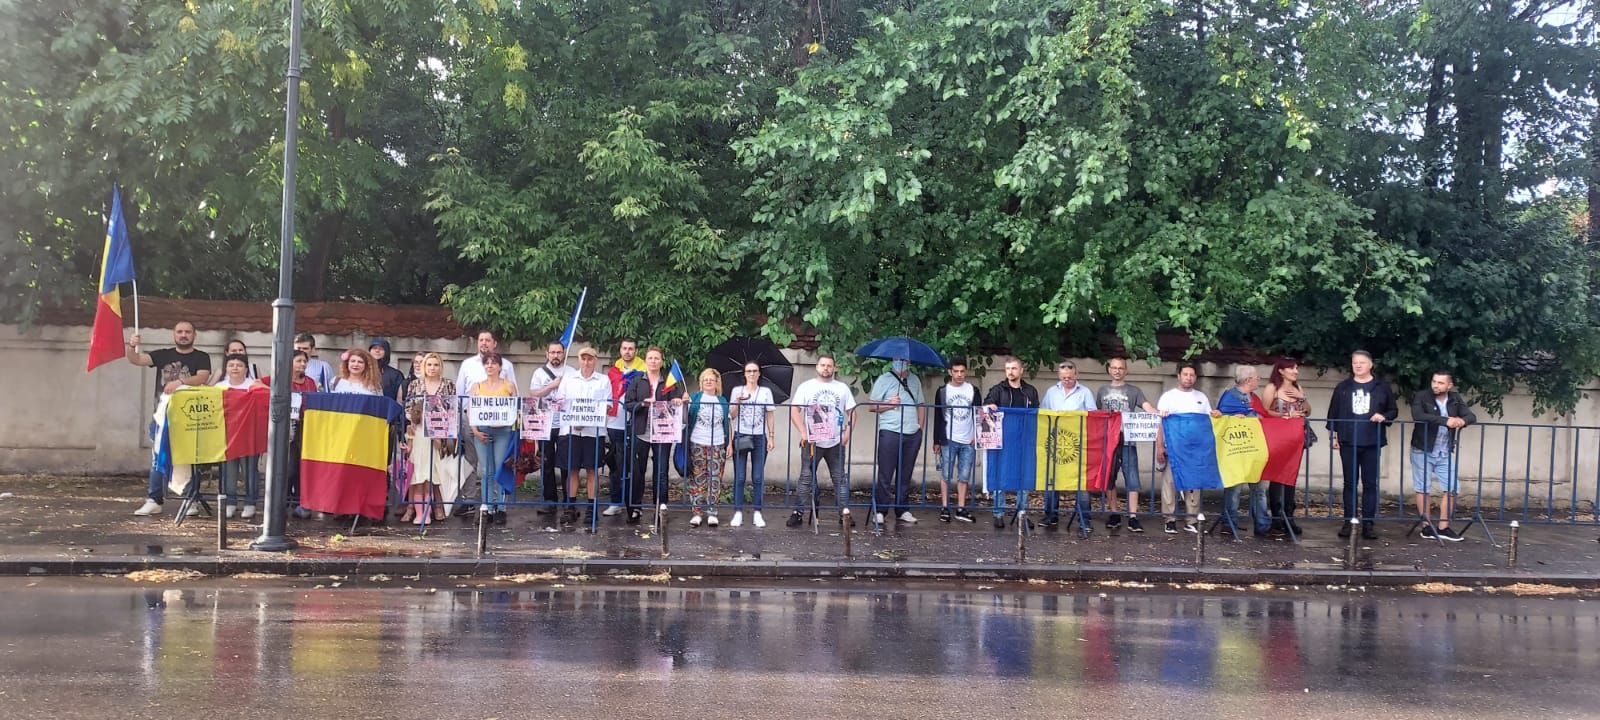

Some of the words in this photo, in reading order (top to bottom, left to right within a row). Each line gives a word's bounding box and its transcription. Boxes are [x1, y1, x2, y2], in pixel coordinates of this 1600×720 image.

[471, 397, 482, 407] NU
[484, 397, 494, 407] NE
[189, 404, 209, 413] AUR
[478, 412, 500, 421] COPIII
[1229, 431, 1249, 440] AUR
